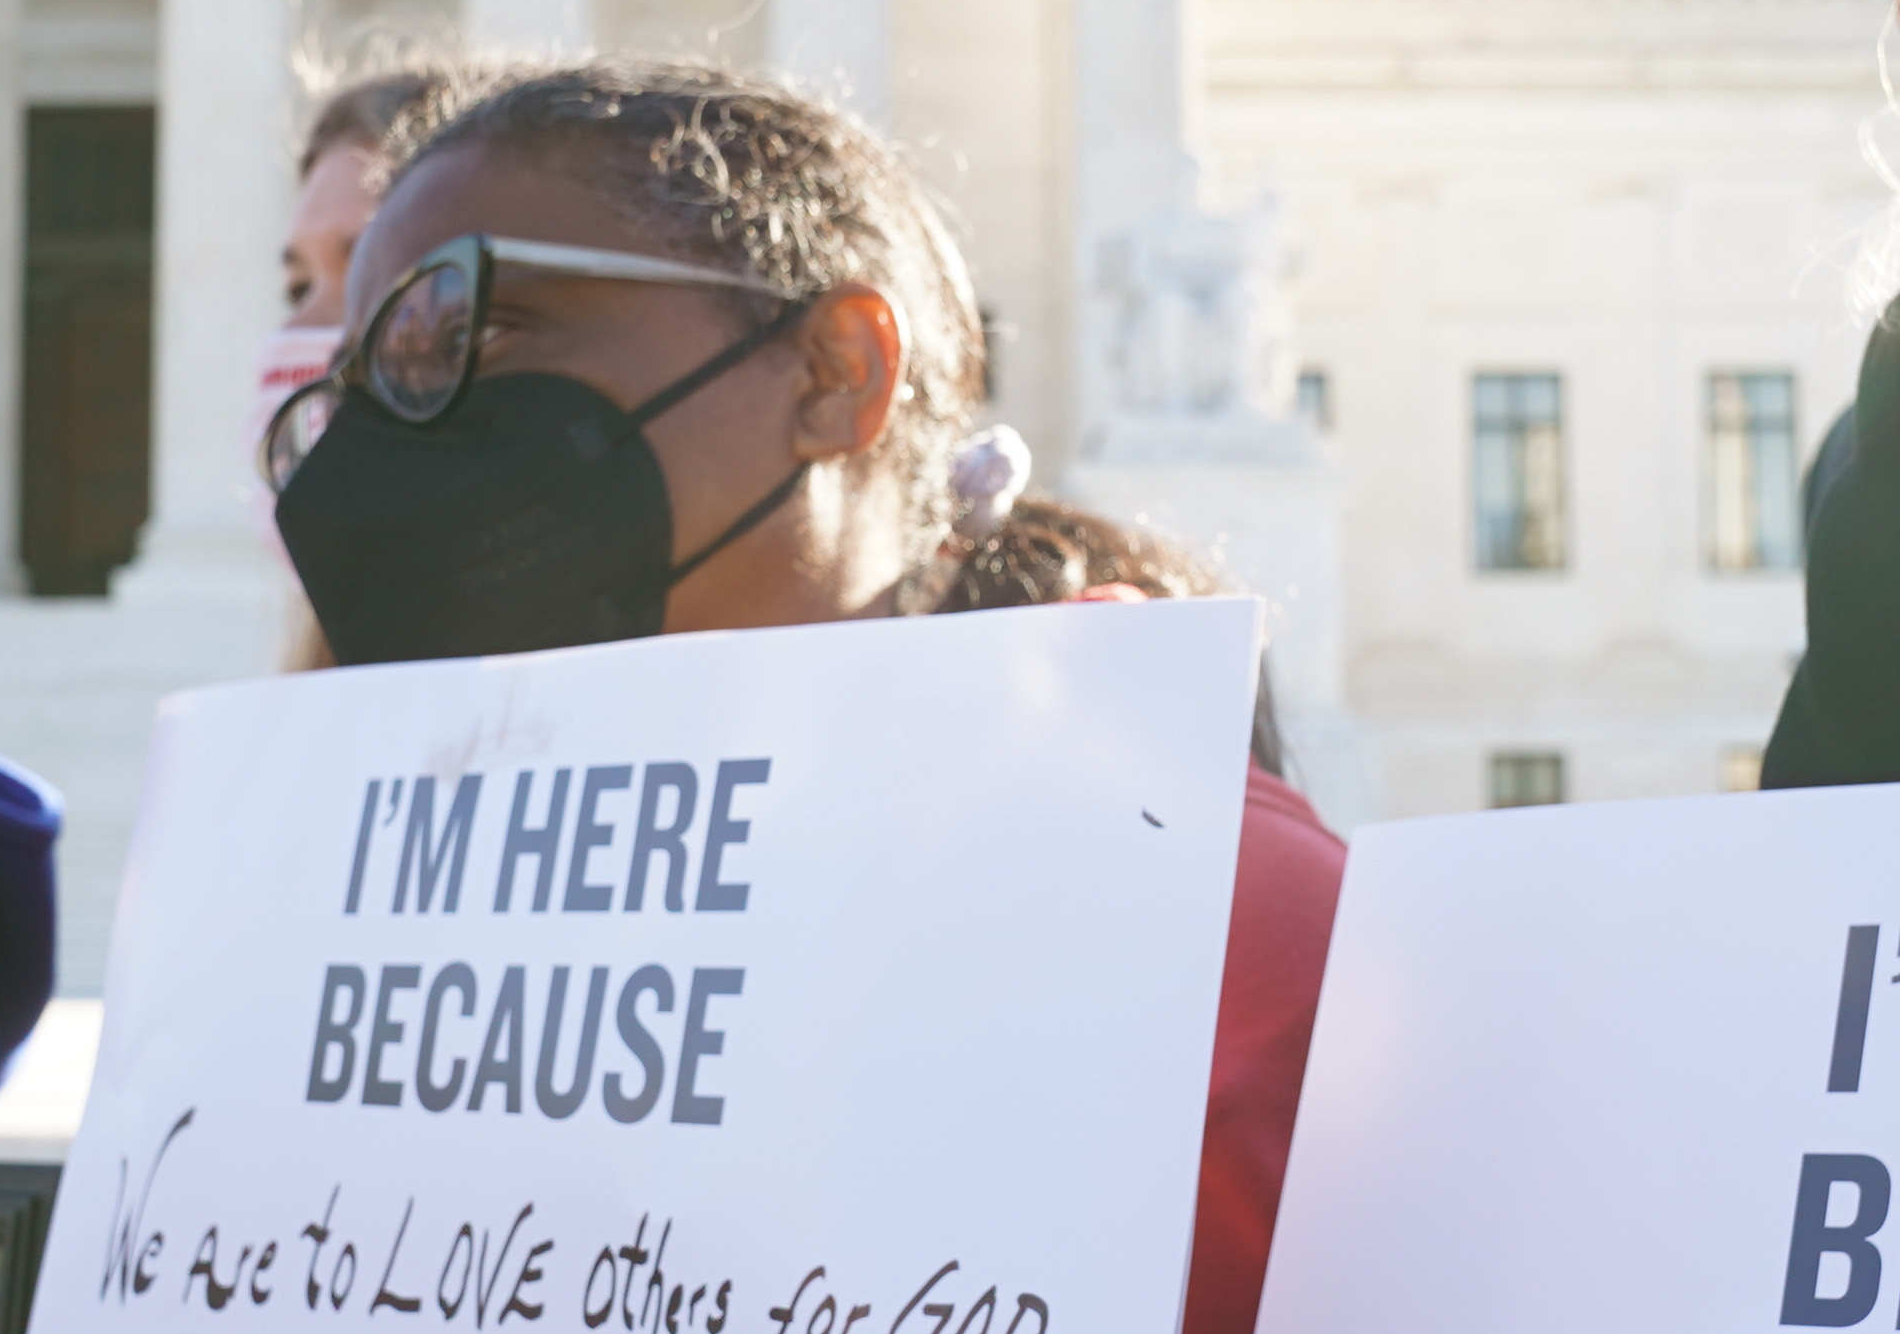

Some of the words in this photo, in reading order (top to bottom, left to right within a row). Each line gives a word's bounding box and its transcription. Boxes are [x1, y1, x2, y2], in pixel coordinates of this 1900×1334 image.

[342, 772, 486, 917] I'M
[491, 756, 773, 914] HERE
[304, 959, 748, 1128] BECAUSE
[99, 1103, 197, 1308] We
[300, 1182, 358, 1313] to
[367, 1194, 556, 1332] LOVE
